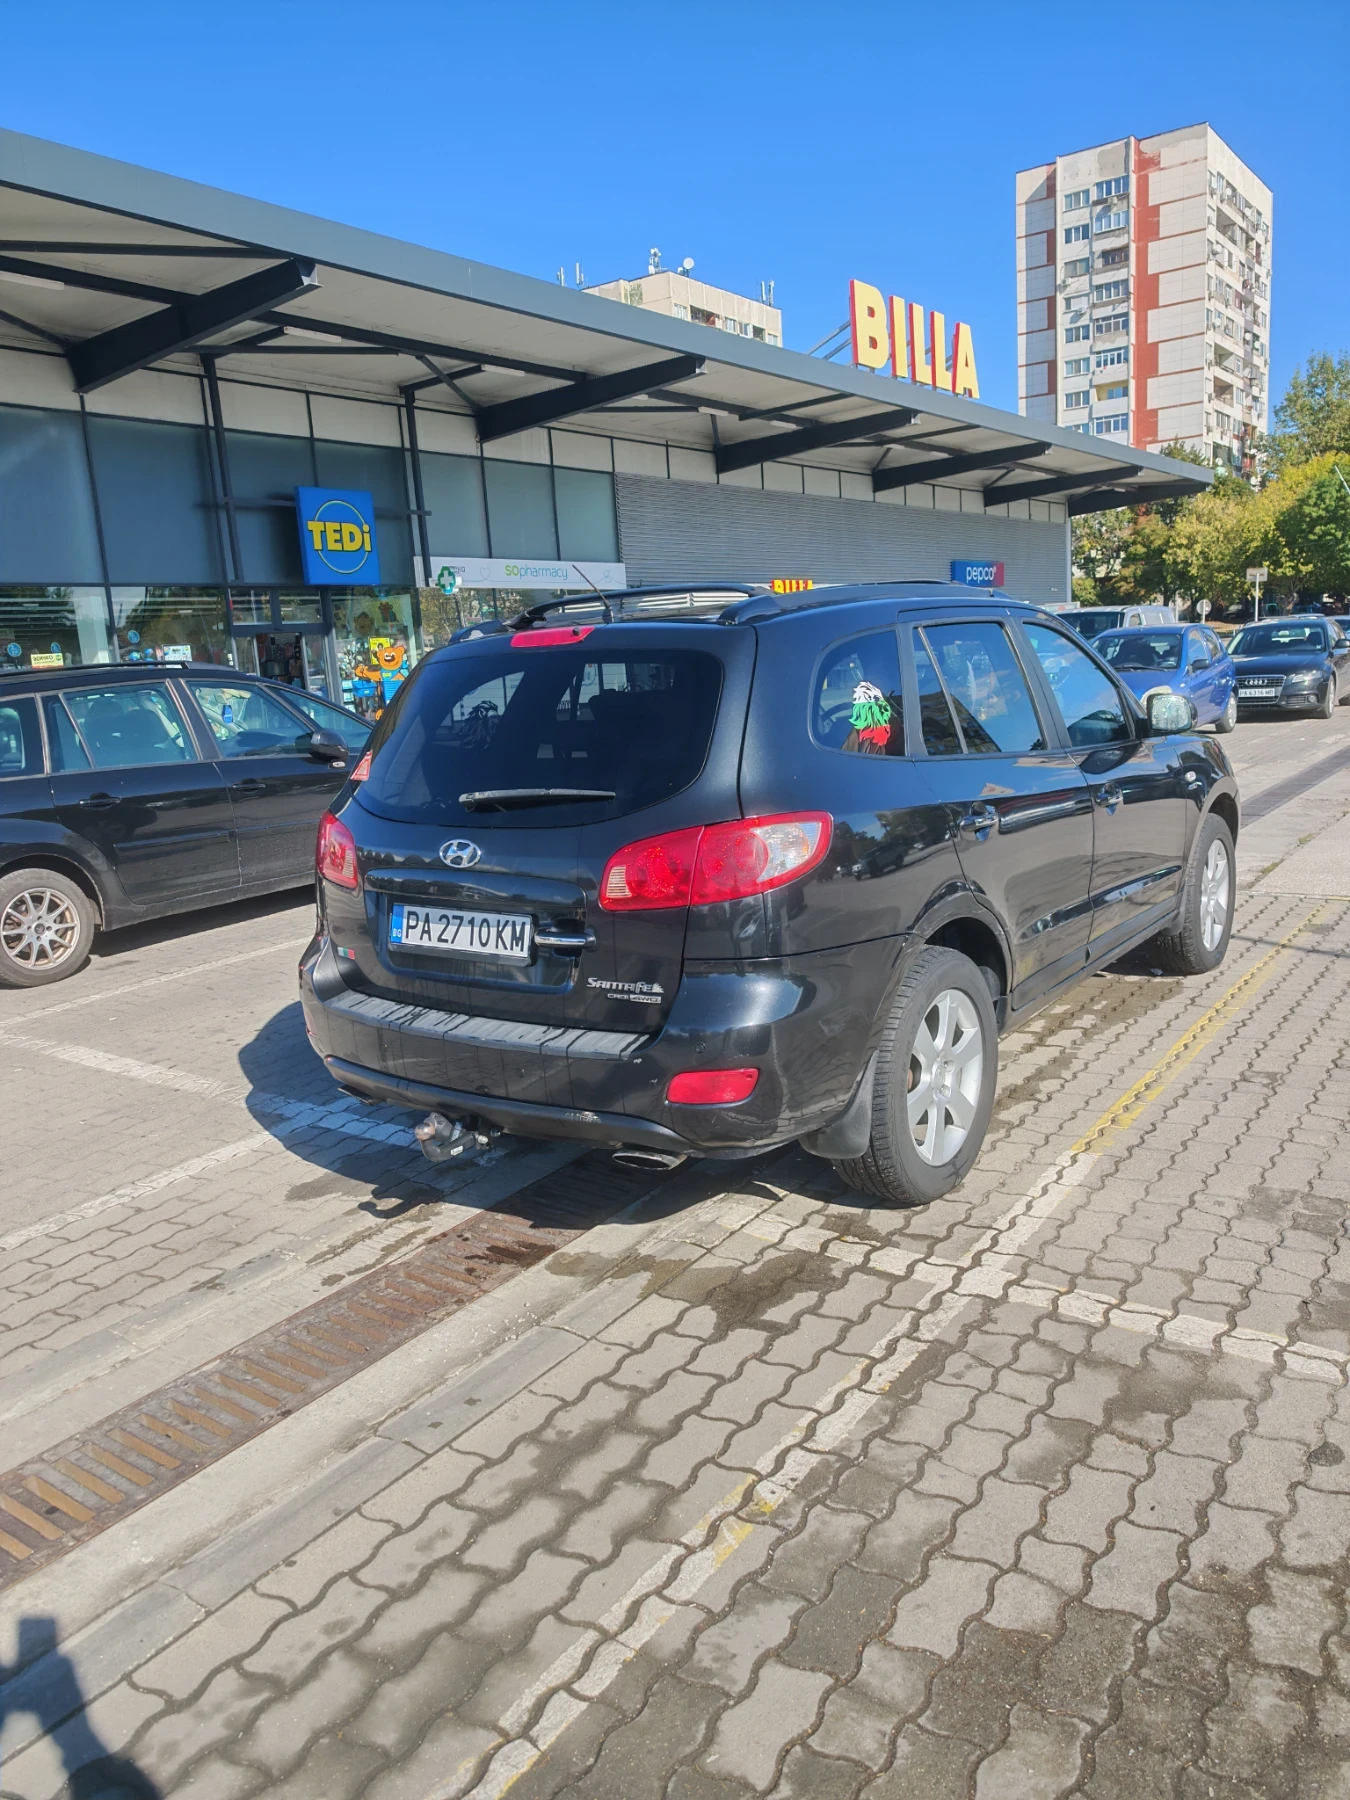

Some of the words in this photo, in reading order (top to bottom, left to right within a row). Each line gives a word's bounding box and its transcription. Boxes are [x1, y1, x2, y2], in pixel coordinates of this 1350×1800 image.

[849, 279, 980, 399] BILLA
[307, 520, 372, 552] TEDi
[966, 566, 995, 584] pepco
[392, 928, 402, 937] BG
